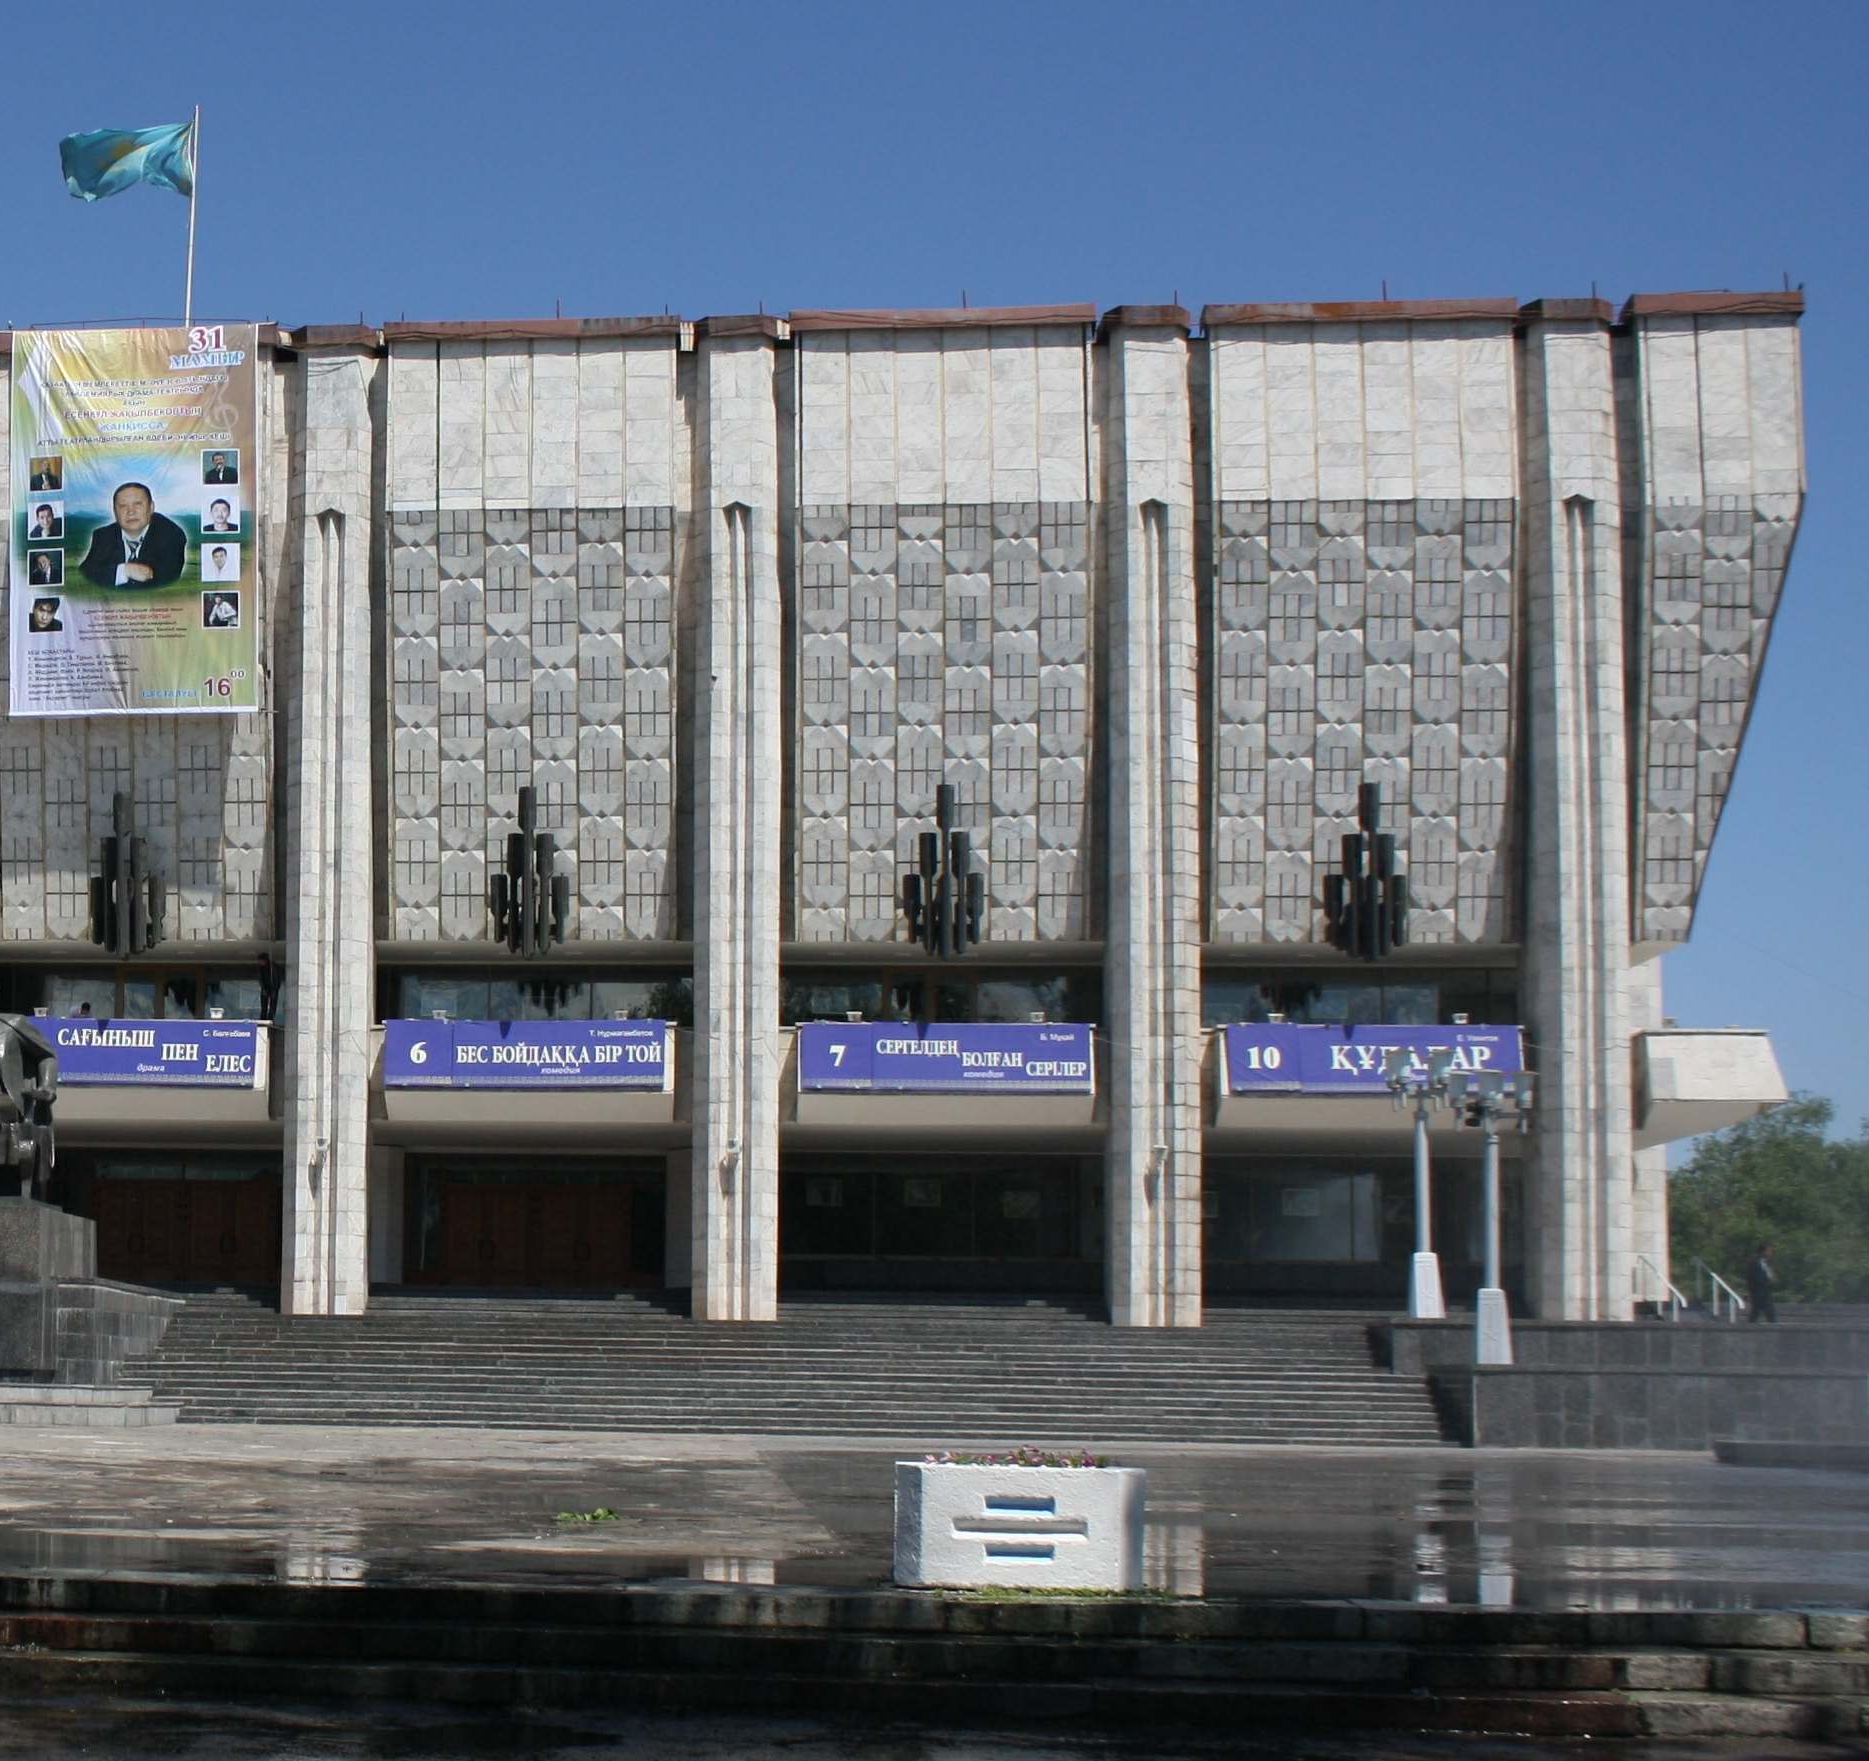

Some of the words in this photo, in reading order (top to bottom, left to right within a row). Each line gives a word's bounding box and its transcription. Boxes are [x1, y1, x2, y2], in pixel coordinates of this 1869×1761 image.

[188, 325, 227, 353] 31
[203, 677, 232, 698] 16
[230, 670, 245, 679] 00
[57, 1028, 156, 1048] САҒЫНЫШ
[161, 1043, 199, 1061] ПЕН
[205, 1054, 251, 1073] ЕЛЕС
[409, 1041, 427, 1064] 6
[456, 1045, 489, 1064] БЕС
[491, 1041, 591, 1069] БОЙДАҚҚА
[594, 1044, 623, 1063] БІР
[625, 1041, 662, 1063] ТОЙ
[829, 1044, 846, 1067] 7
[876, 1039, 961, 1058] СЕРГЕЛДЕҢ
[961, 1051, 1023, 1067] БОЛҒАН
[1025, 1061, 1087, 1077] СЕРІЛЕР
[1247, 1046, 1281, 1069] 10
